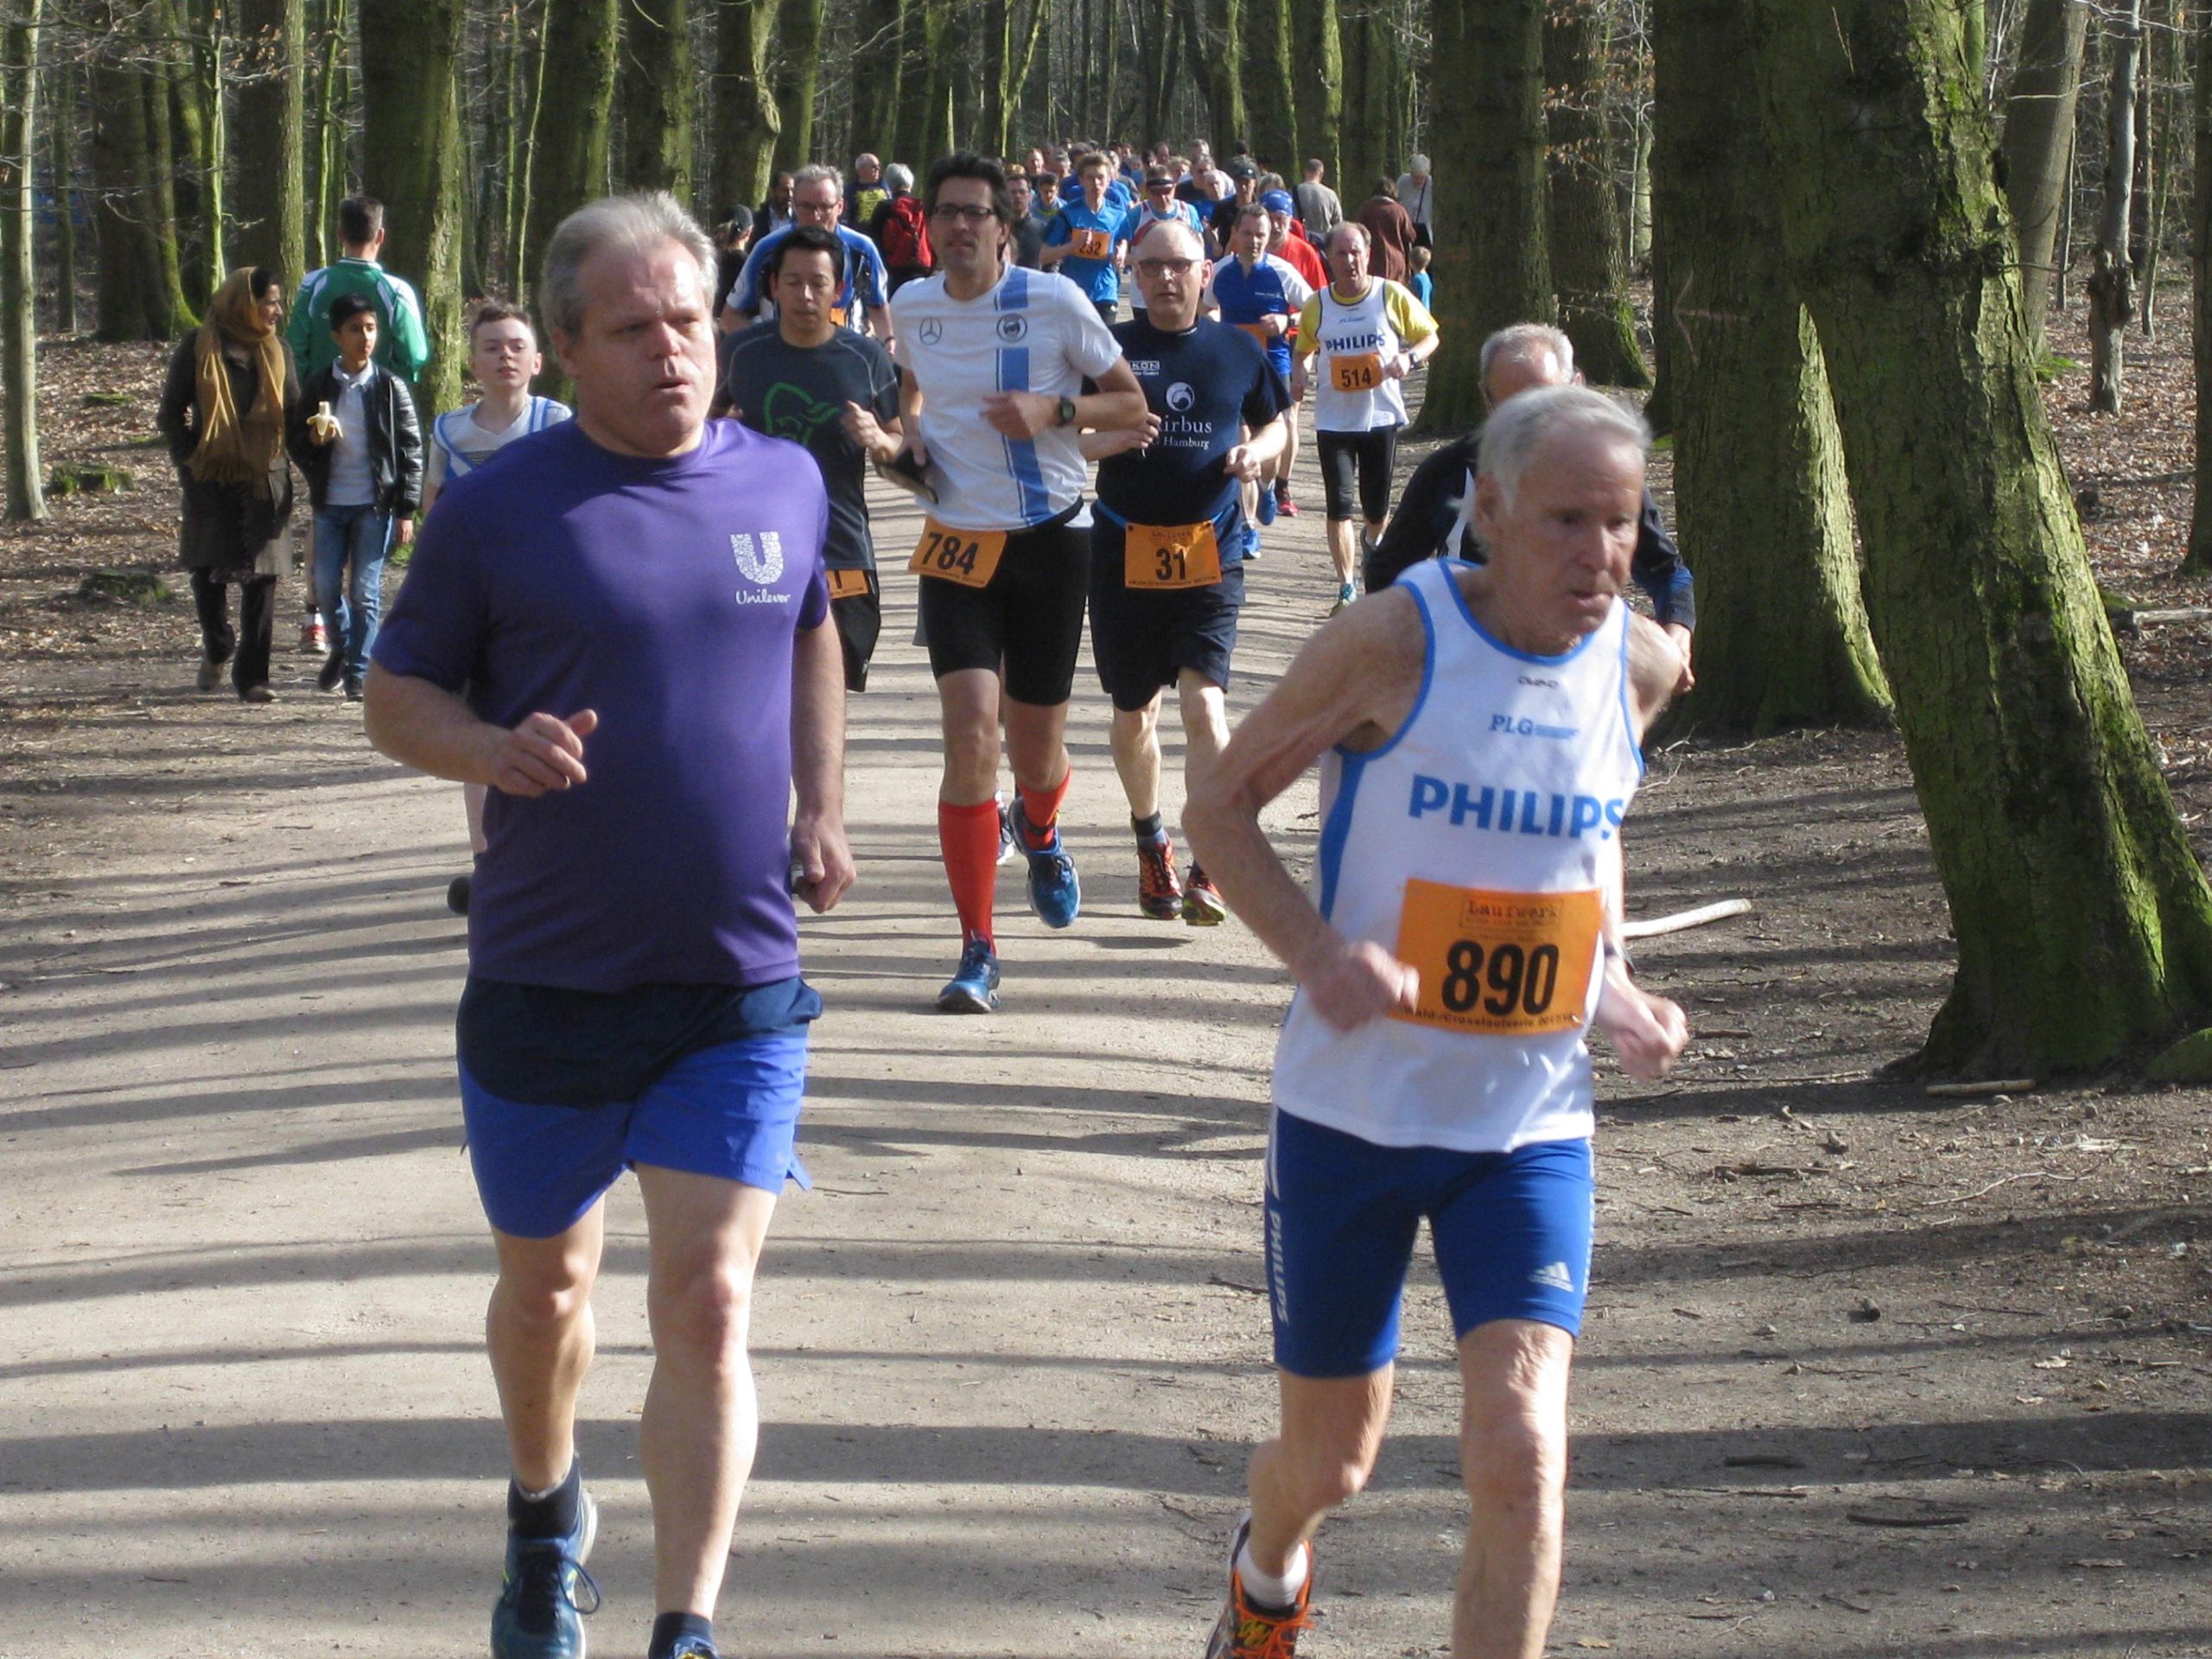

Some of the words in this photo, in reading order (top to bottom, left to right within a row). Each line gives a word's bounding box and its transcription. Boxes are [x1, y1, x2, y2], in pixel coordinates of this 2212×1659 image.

[1325, 334, 1386, 351] PHILIPS
[1340, 367, 1371, 387] 514
[1163, 435, 1211, 450] Hamburg
[921, 531, 979, 575] 784
[1155, 547, 1186, 581] 31
[735, 588, 791, 605] Unilever
[1489, 714, 1535, 735] PLG
[1408, 773, 1624, 841] PHILIPS
[1441, 939, 1560, 1016] 890
[1269, 1211, 1288, 1325] PHILIPS
